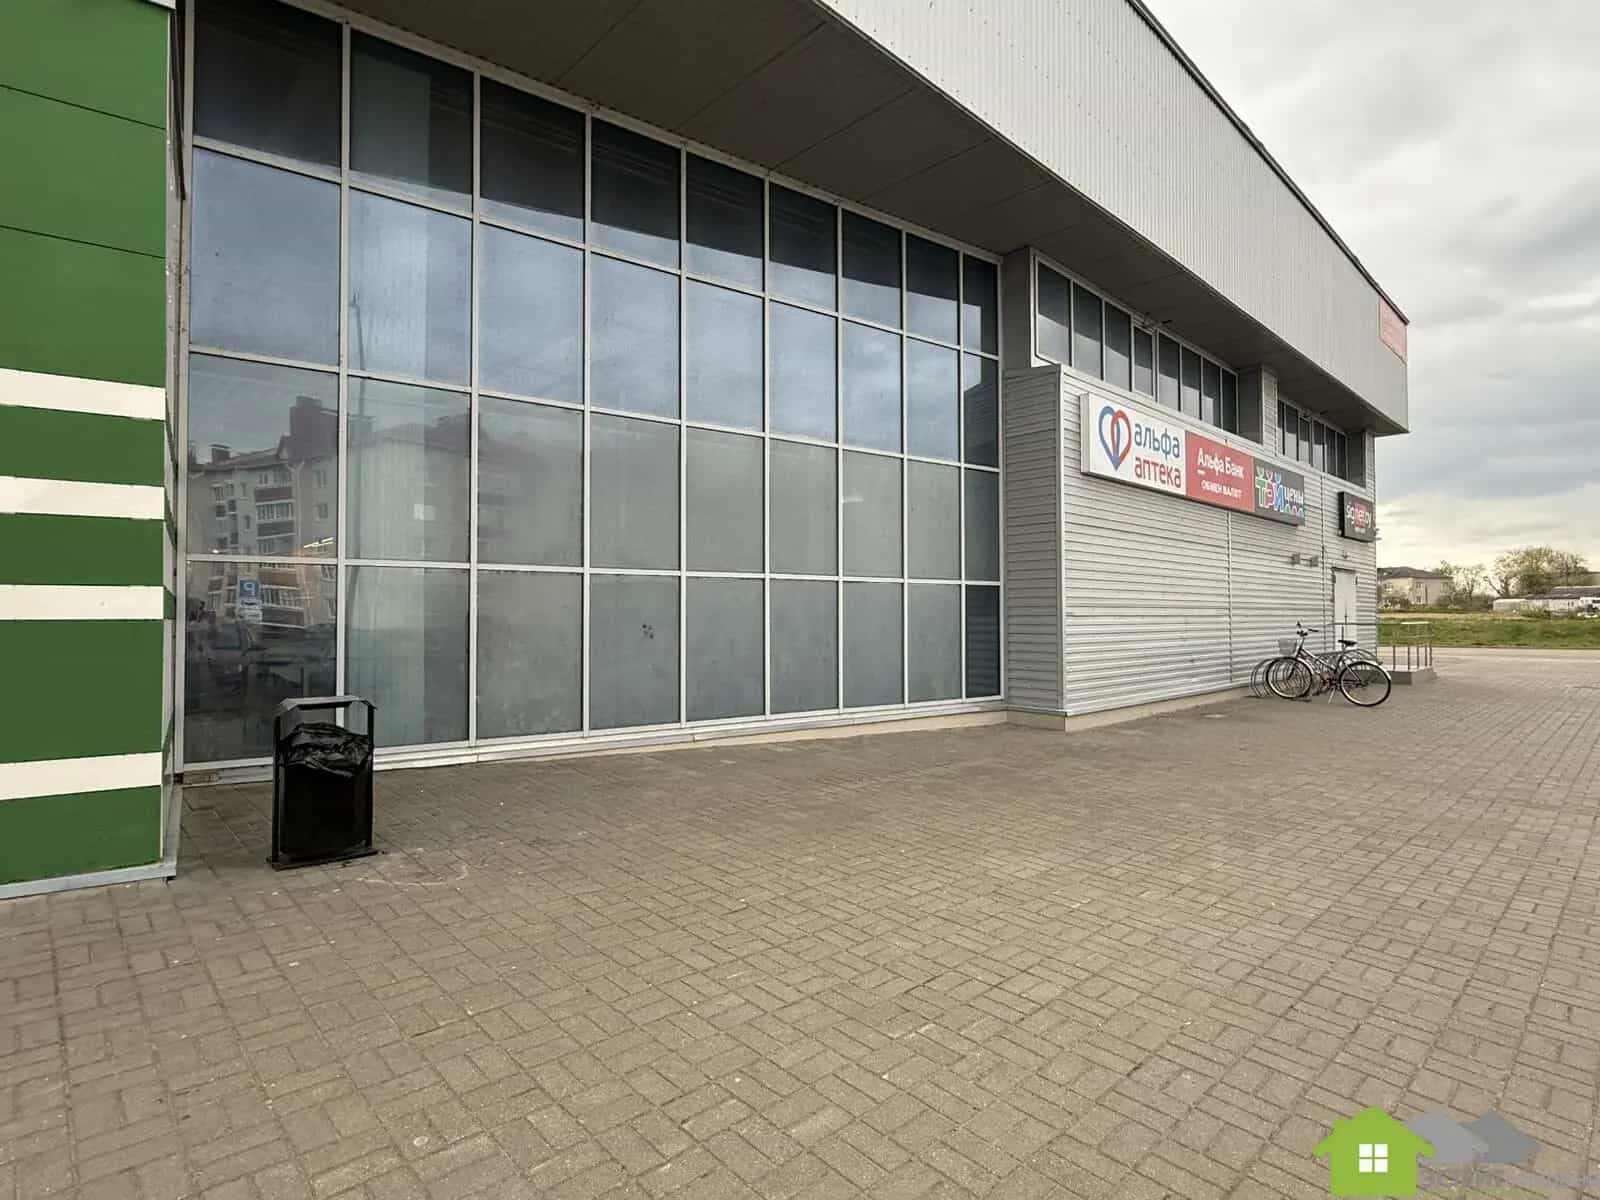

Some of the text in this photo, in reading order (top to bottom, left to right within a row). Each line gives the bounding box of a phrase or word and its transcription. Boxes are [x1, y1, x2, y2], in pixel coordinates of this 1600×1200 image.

[1134, 423, 1180, 461] альфа
[1134, 456, 1182, 488] аптека
[1197, 448, 1245, 479] Альфа Банк
